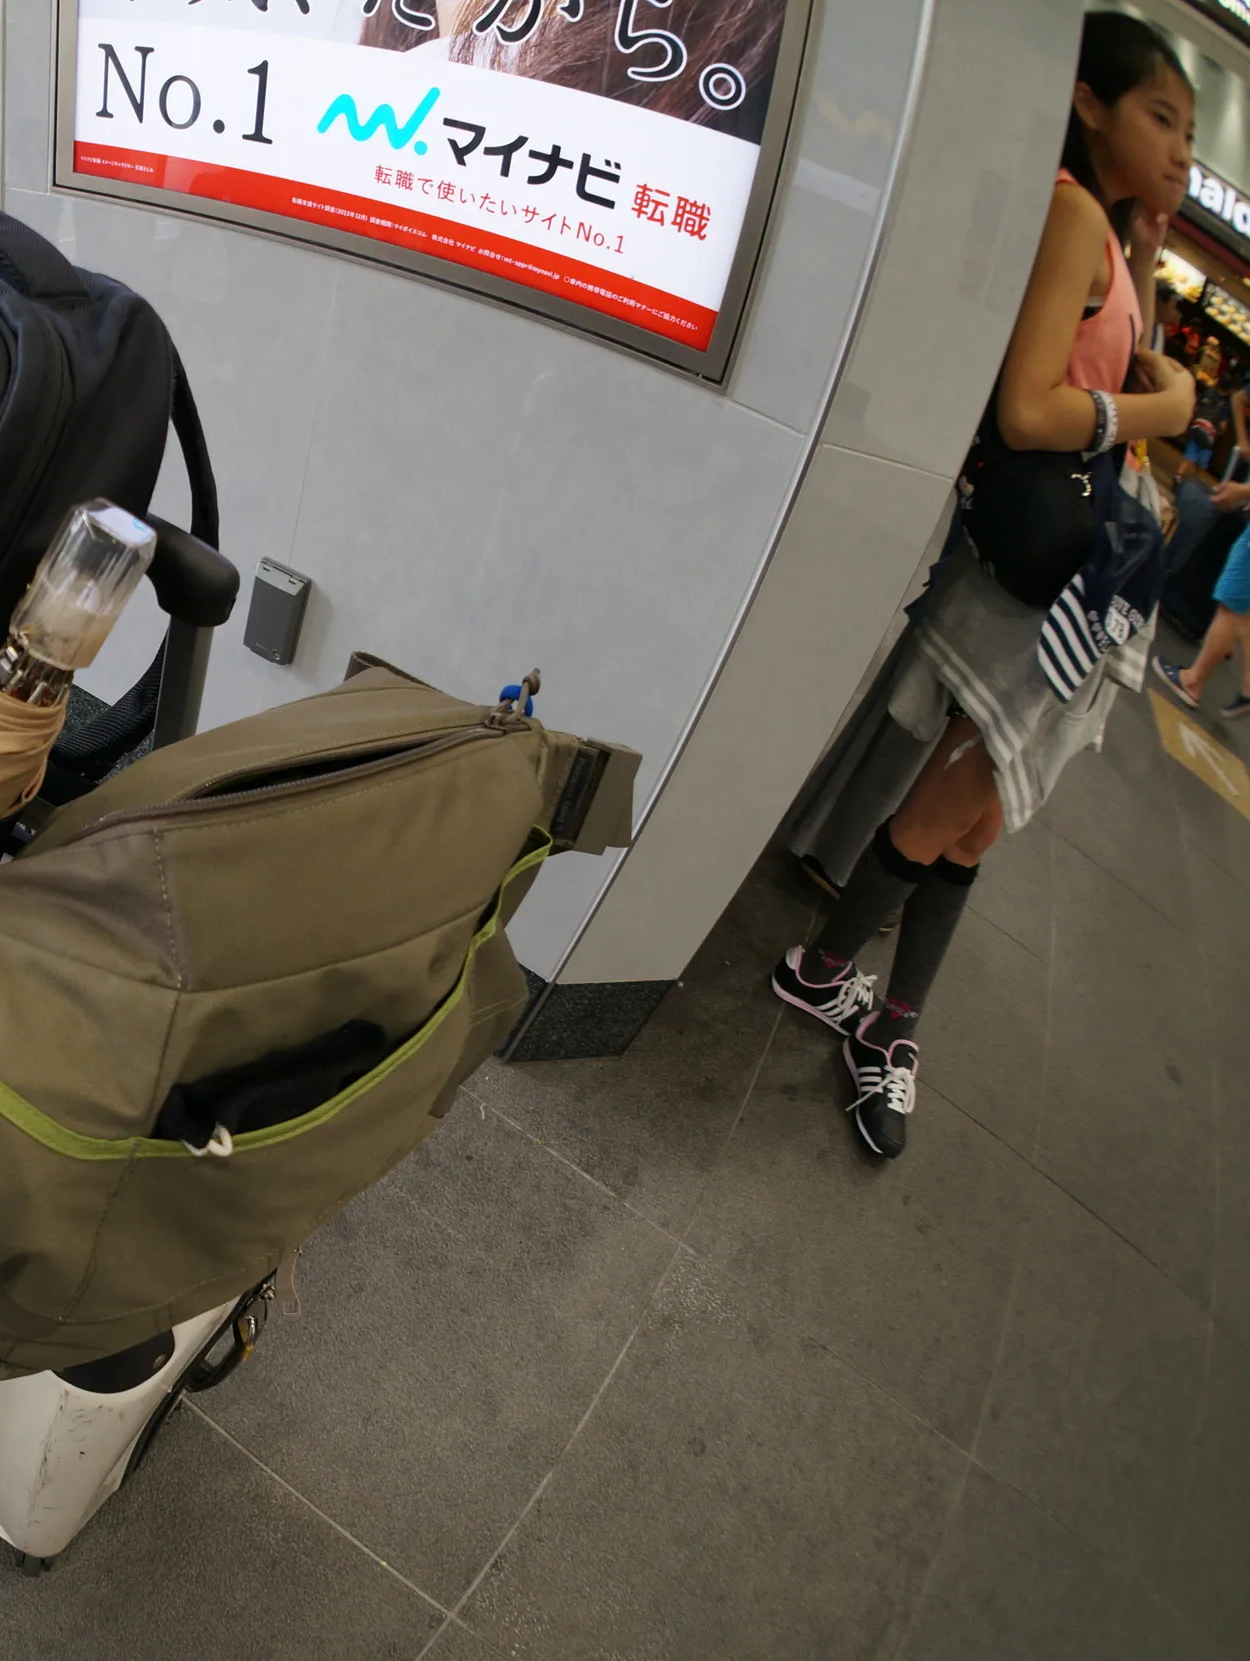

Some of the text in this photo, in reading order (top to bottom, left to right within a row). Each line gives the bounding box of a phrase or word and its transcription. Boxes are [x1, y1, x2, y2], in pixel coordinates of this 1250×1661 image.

[96, 43, 273, 145] No.1
[373, 164, 625, 255] 転職で使いたいサイトNo.1
[441, 117, 712, 242] マイナビ 転職
[455, 241, 477, 252] マイナビ
